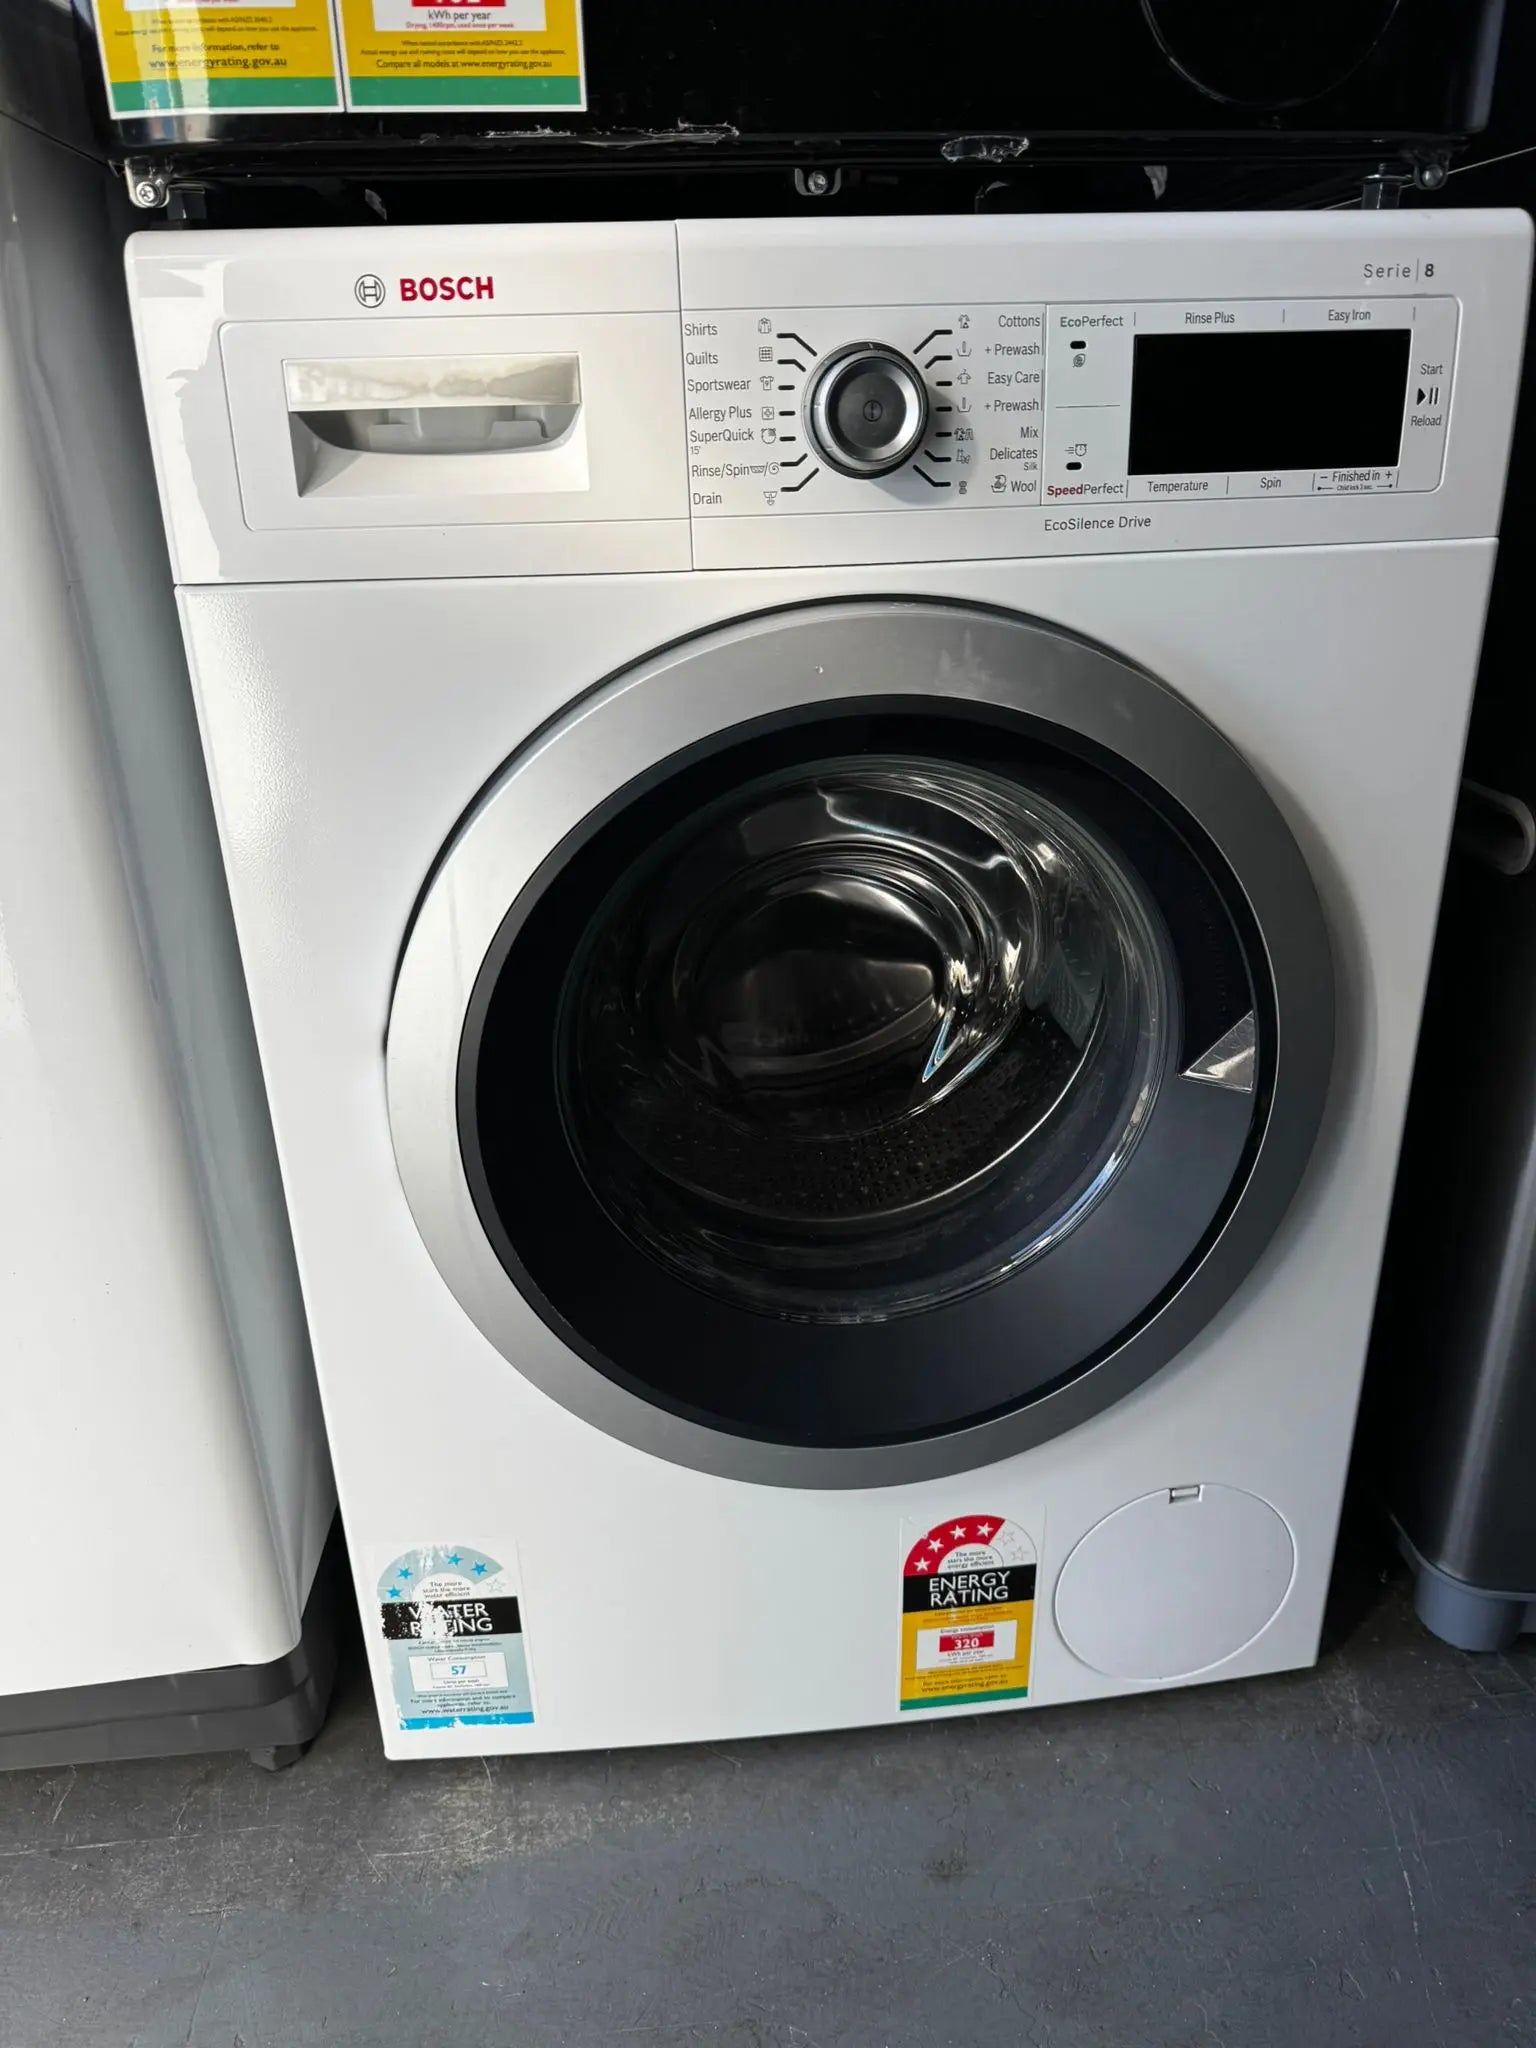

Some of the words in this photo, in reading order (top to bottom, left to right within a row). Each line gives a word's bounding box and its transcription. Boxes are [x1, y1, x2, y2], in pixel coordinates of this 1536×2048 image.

[428, 9, 451, 20] kWh
[453, 12, 469, 22] per
[471, 12, 492, 22] year
[247, 42, 268, 51] refer
[270, 43, 280, 51] to
[376, 59, 412, 70] Compare
[413, 59, 421, 68] all
[423, 59, 449, 68] models
[1363, 263, 1411, 279] Serie
[1424, 263, 1435, 278] 8
[400, 276, 494, 302] BOSCH
[998, 315, 1041, 328] Cottons
[1060, 315, 1124, 328] EcoPerfect
[1185, 312, 1212, 325] Rinse
[1214, 311, 1235, 323] Plus
[1328, 309, 1351, 323] Easy
[1352, 308, 1371, 321] Iron
[684, 323, 718, 337] Shirts
[994, 343, 1041, 356] Prewash
[686, 352, 719, 366] Quilts
[1420, 363, 1443, 376] Start
[987, 372, 1013, 386] Easy
[1014, 371, 1040, 384] Care
[687, 378, 752, 395] Sportswear
[994, 399, 1040, 412] Prewash
[689, 407, 726, 422] Allergy
[728, 405, 752, 419] Plus
[1410, 415, 1441, 428] Reload
[689, 428, 755, 444] SuperQuick
[1020, 426, 1039, 439] Mix
[990, 447, 1038, 461] Delicates
[691, 463, 750, 478] Rinse/Spin
[1023, 462, 1038, 471] Silk
[1332, 469, 1371, 482] Finished
[1371, 469, 1380, 481] in
[1011, 480, 1037, 492] Wool
[1047, 483, 1124, 498] SpeedPerfect
[1147, 480, 1209, 494] Temperature
[1260, 477, 1282, 490] Spin
[693, 492, 722, 505] Drain
[1044, 517, 1115, 531] EcoSilence
[1118, 515, 1152, 528] Drive
[929, 1571, 1011, 1593] ENERGY
[930, 1585, 1009, 1608] RATING
[409, 1617, 493, 1636] RTING
[954, 1637, 980, 1650] 320
[451, 1665, 467, 1676] 57
